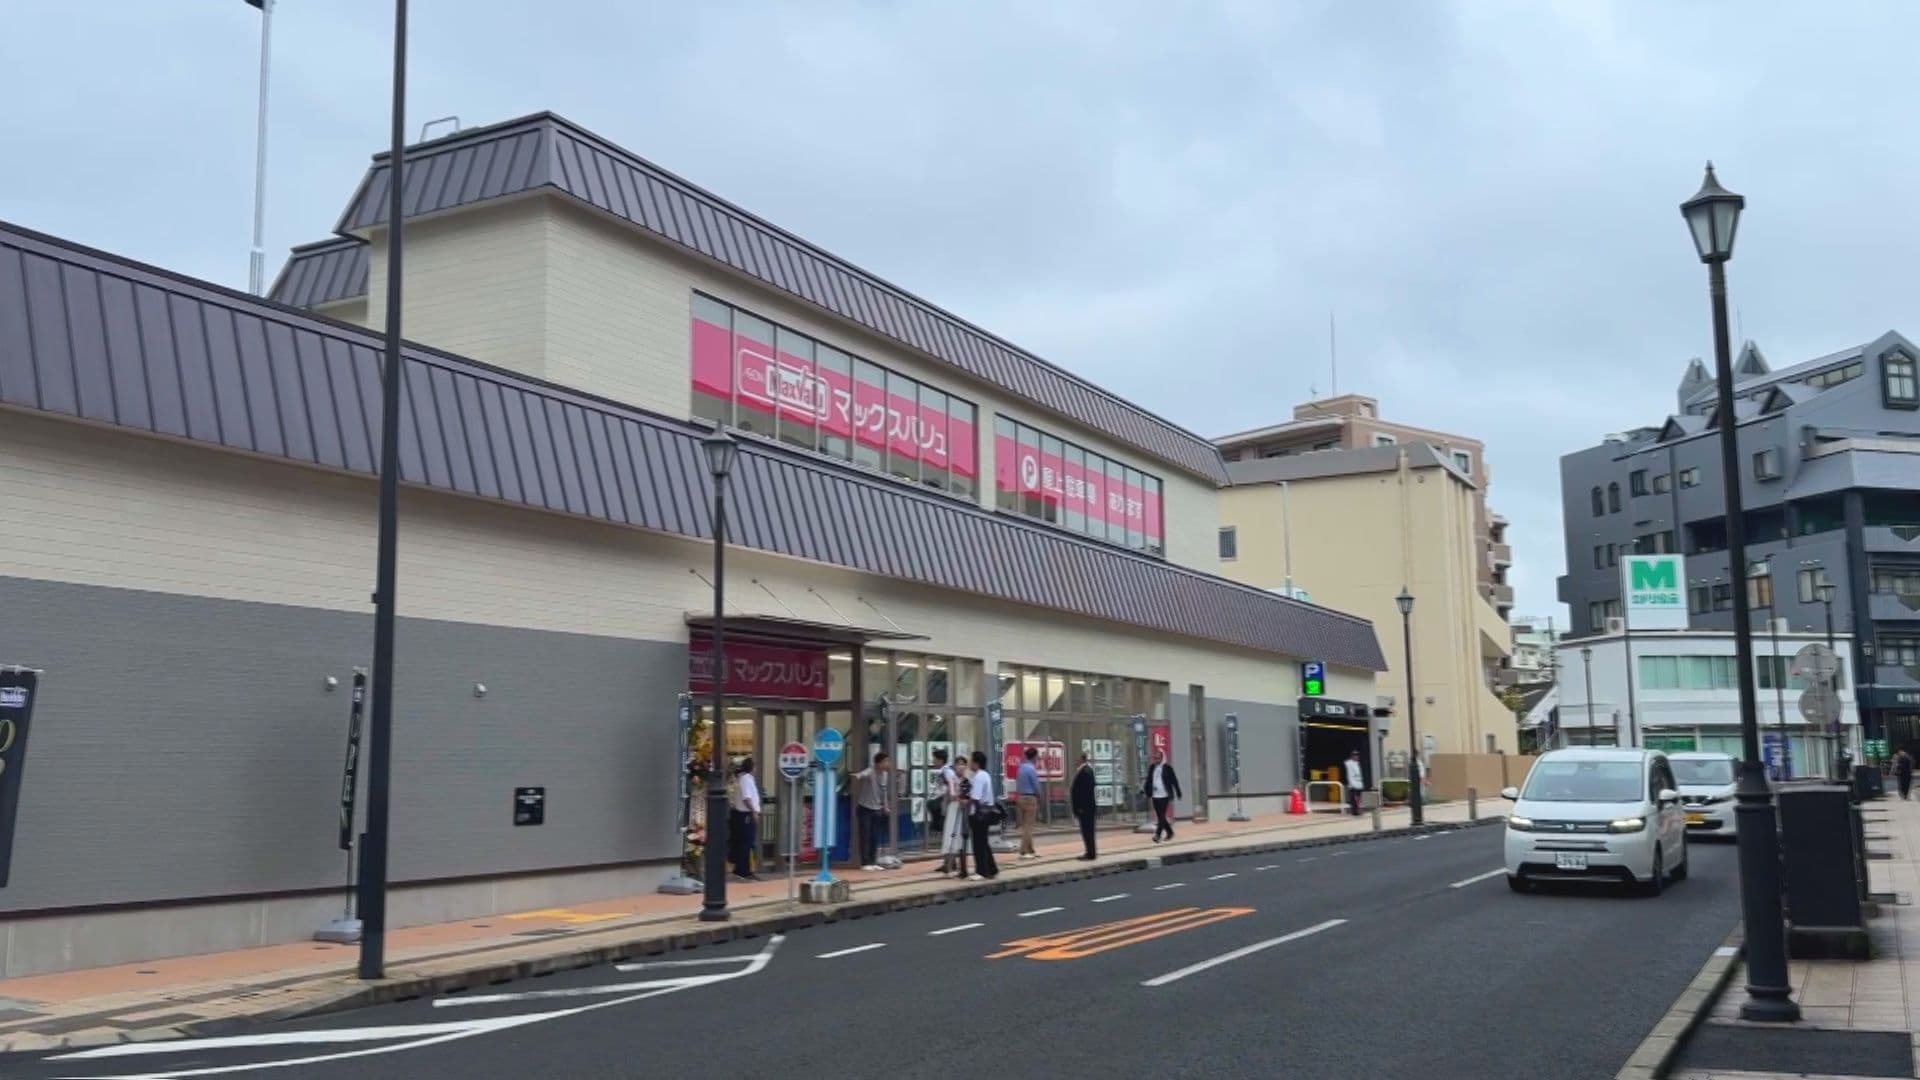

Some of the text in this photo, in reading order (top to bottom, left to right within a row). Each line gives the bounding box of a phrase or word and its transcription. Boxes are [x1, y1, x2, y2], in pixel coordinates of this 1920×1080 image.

[833, 388, 947, 457] マックスバリュ
[1631, 560, 1677, 590] M
[733, 658, 825, 688] マックスバリュ
[1304, 664, 1320, 678] P
